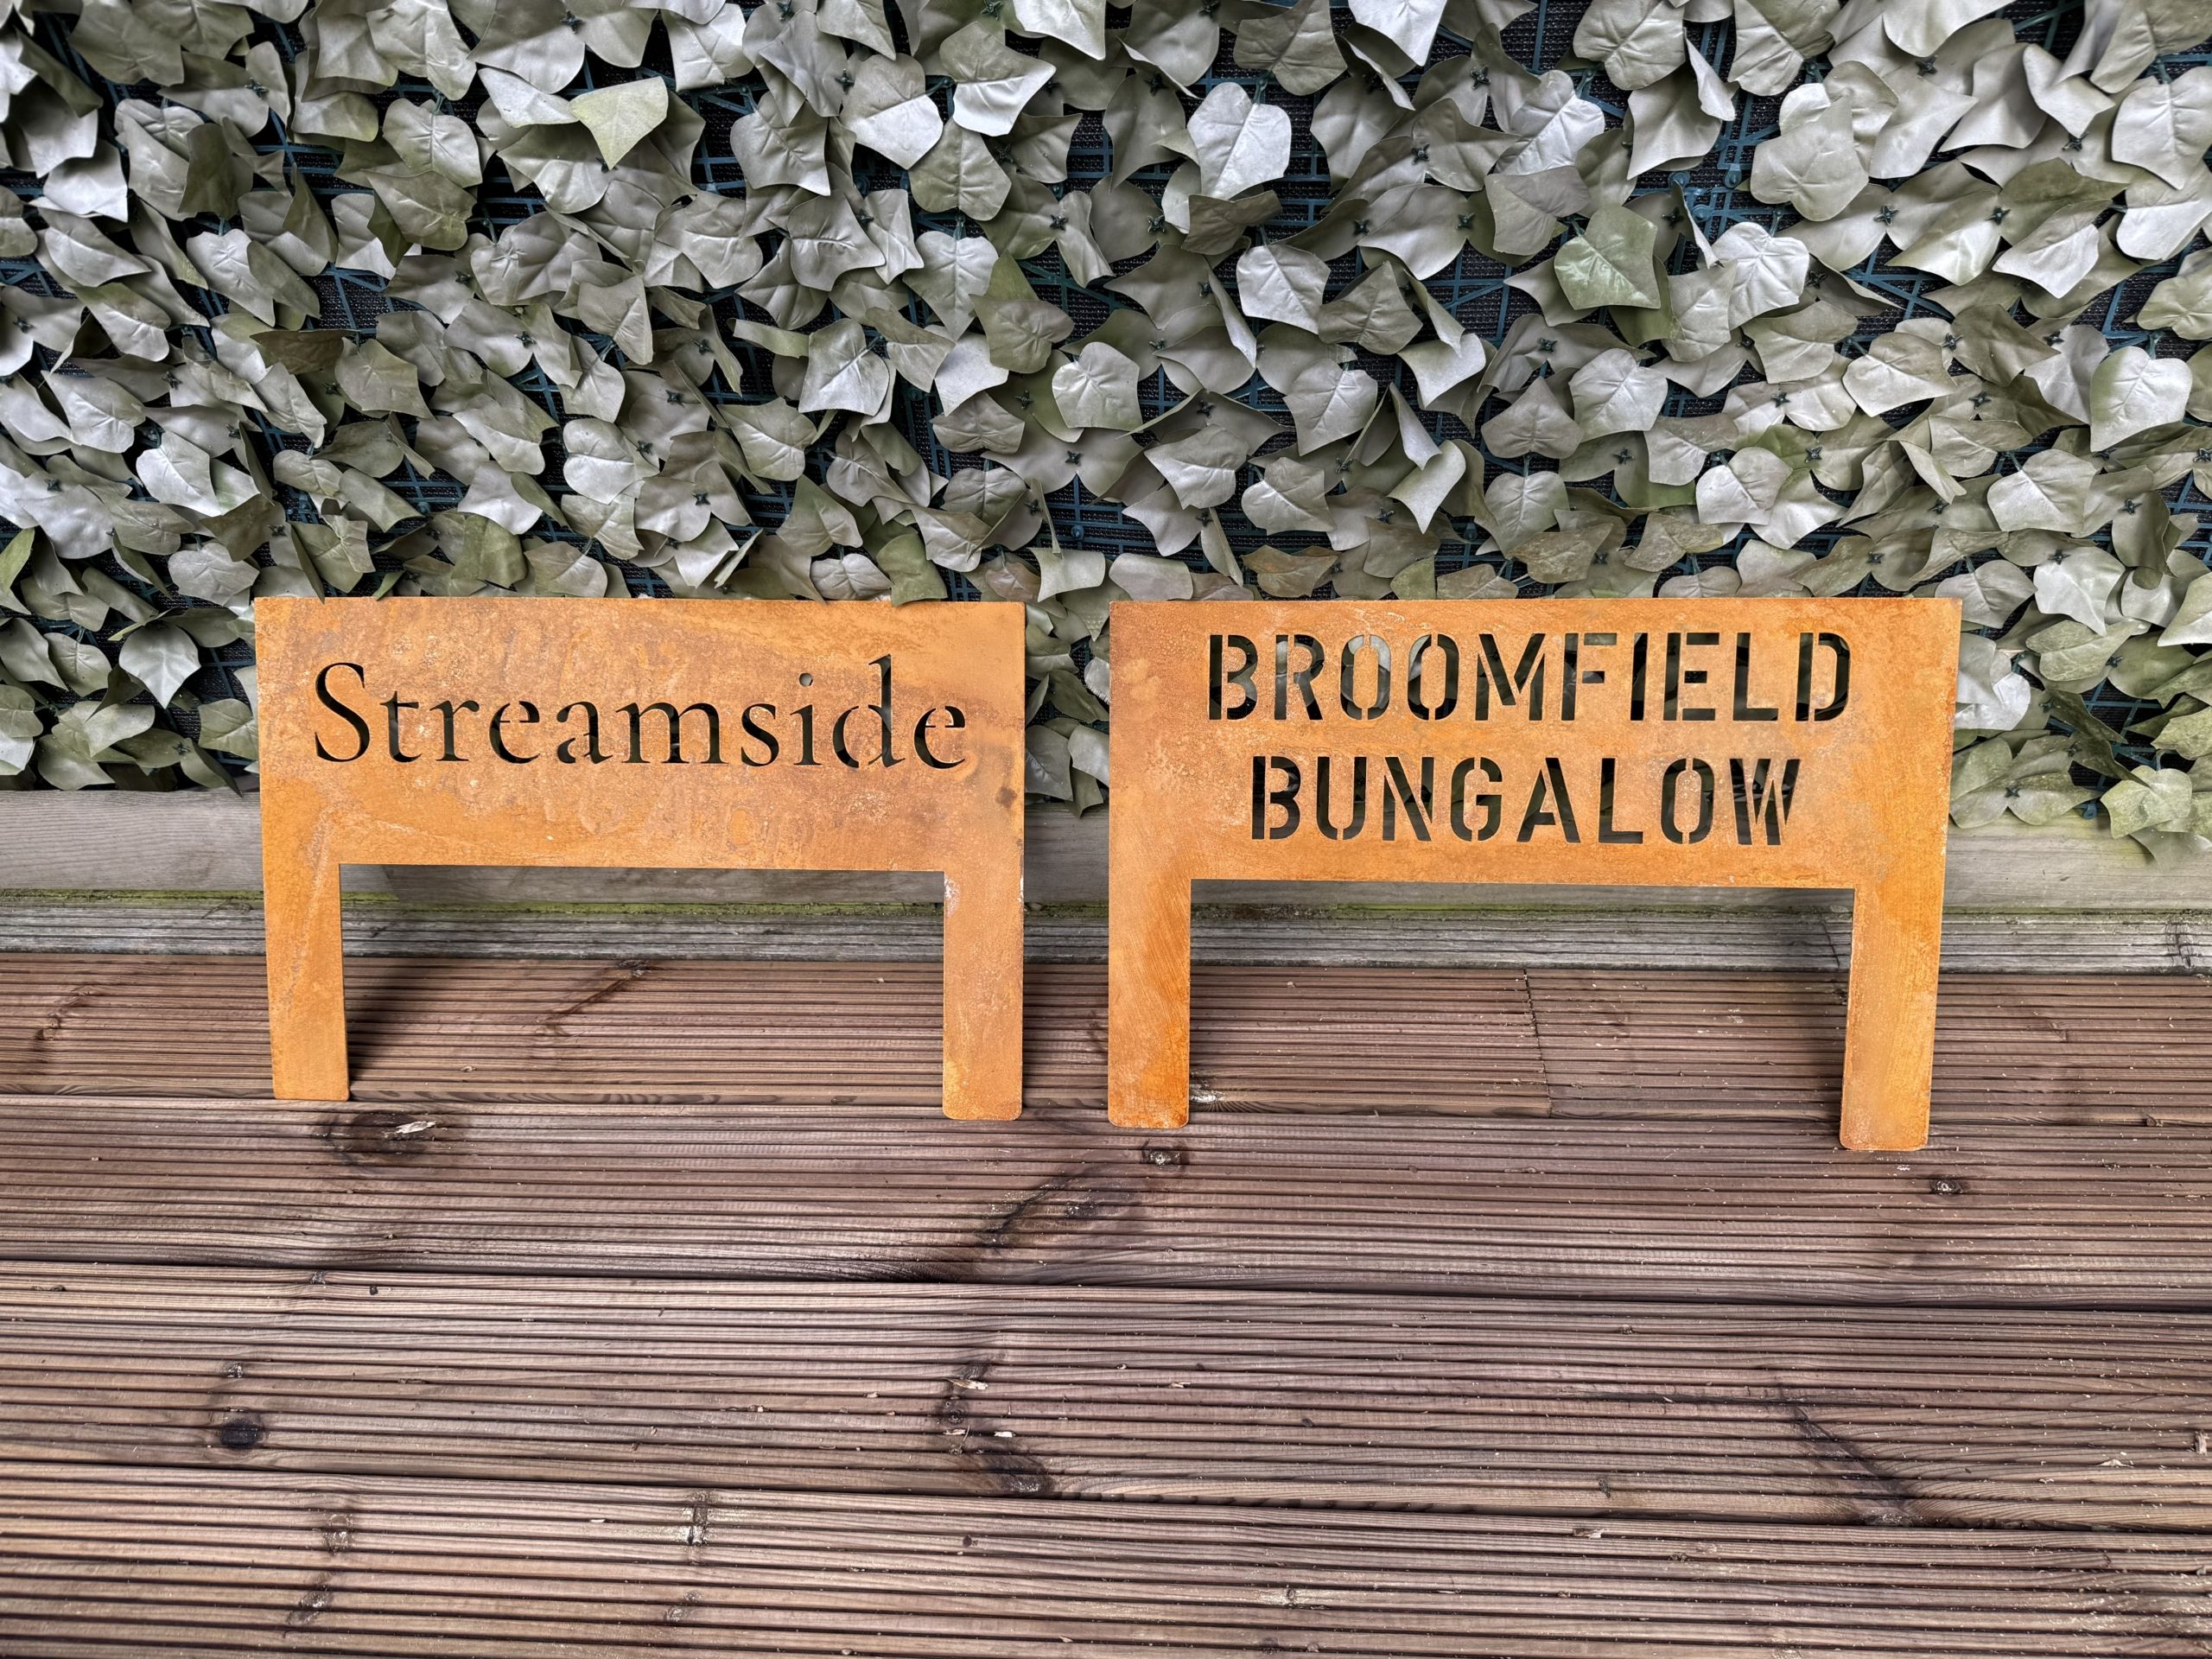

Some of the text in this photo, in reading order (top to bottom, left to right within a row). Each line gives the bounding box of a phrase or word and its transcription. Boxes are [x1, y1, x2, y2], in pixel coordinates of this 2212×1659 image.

[314, 653, 967, 769] Streamside
[1207, 632, 1850, 721] BROOMFIELD
[1250, 754, 1802, 846] BUNGALOW
